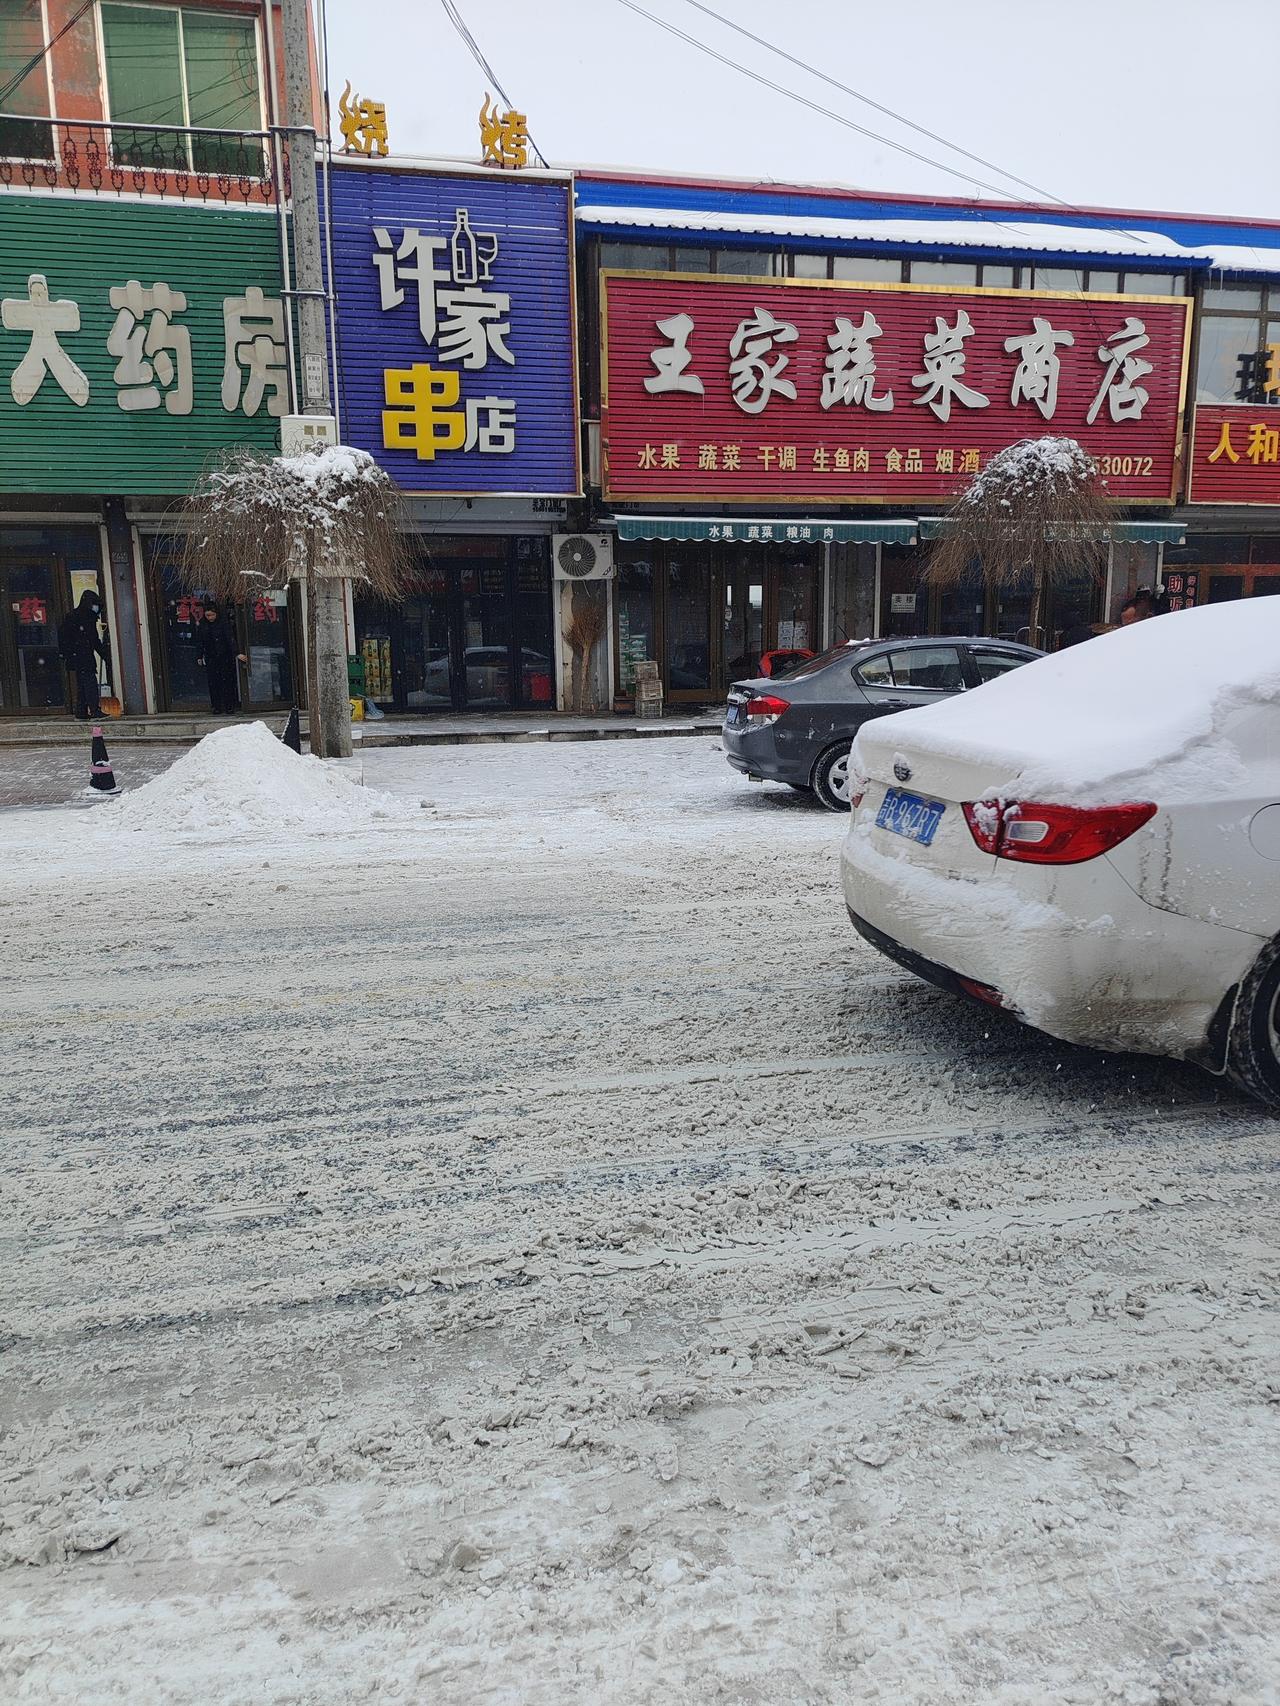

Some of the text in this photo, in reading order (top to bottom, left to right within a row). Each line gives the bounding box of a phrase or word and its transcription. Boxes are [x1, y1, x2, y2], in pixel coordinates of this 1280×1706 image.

[338, 79, 527, 166] 烧烤
[372, 228, 515, 370] 许家
[2, 274, 290, 417] 大药房
[643, 306, 1154, 424] 王家蔬菜商店
[381, 363, 517, 461] 串店
[637, 443, 681, 470] 水果
[698, 444, 742, 471] 蔬菜
[757, 446, 797, 471] 干调
[812, 447, 870, 472] 生鱼肉
[884, 448, 923, 473] 食品
[935, 448, 981, 473] 烟酒
[1207, 421, 1279, 465] 人和
[708, 525, 834, 539] 水果 蔬菜 粮油 肉
